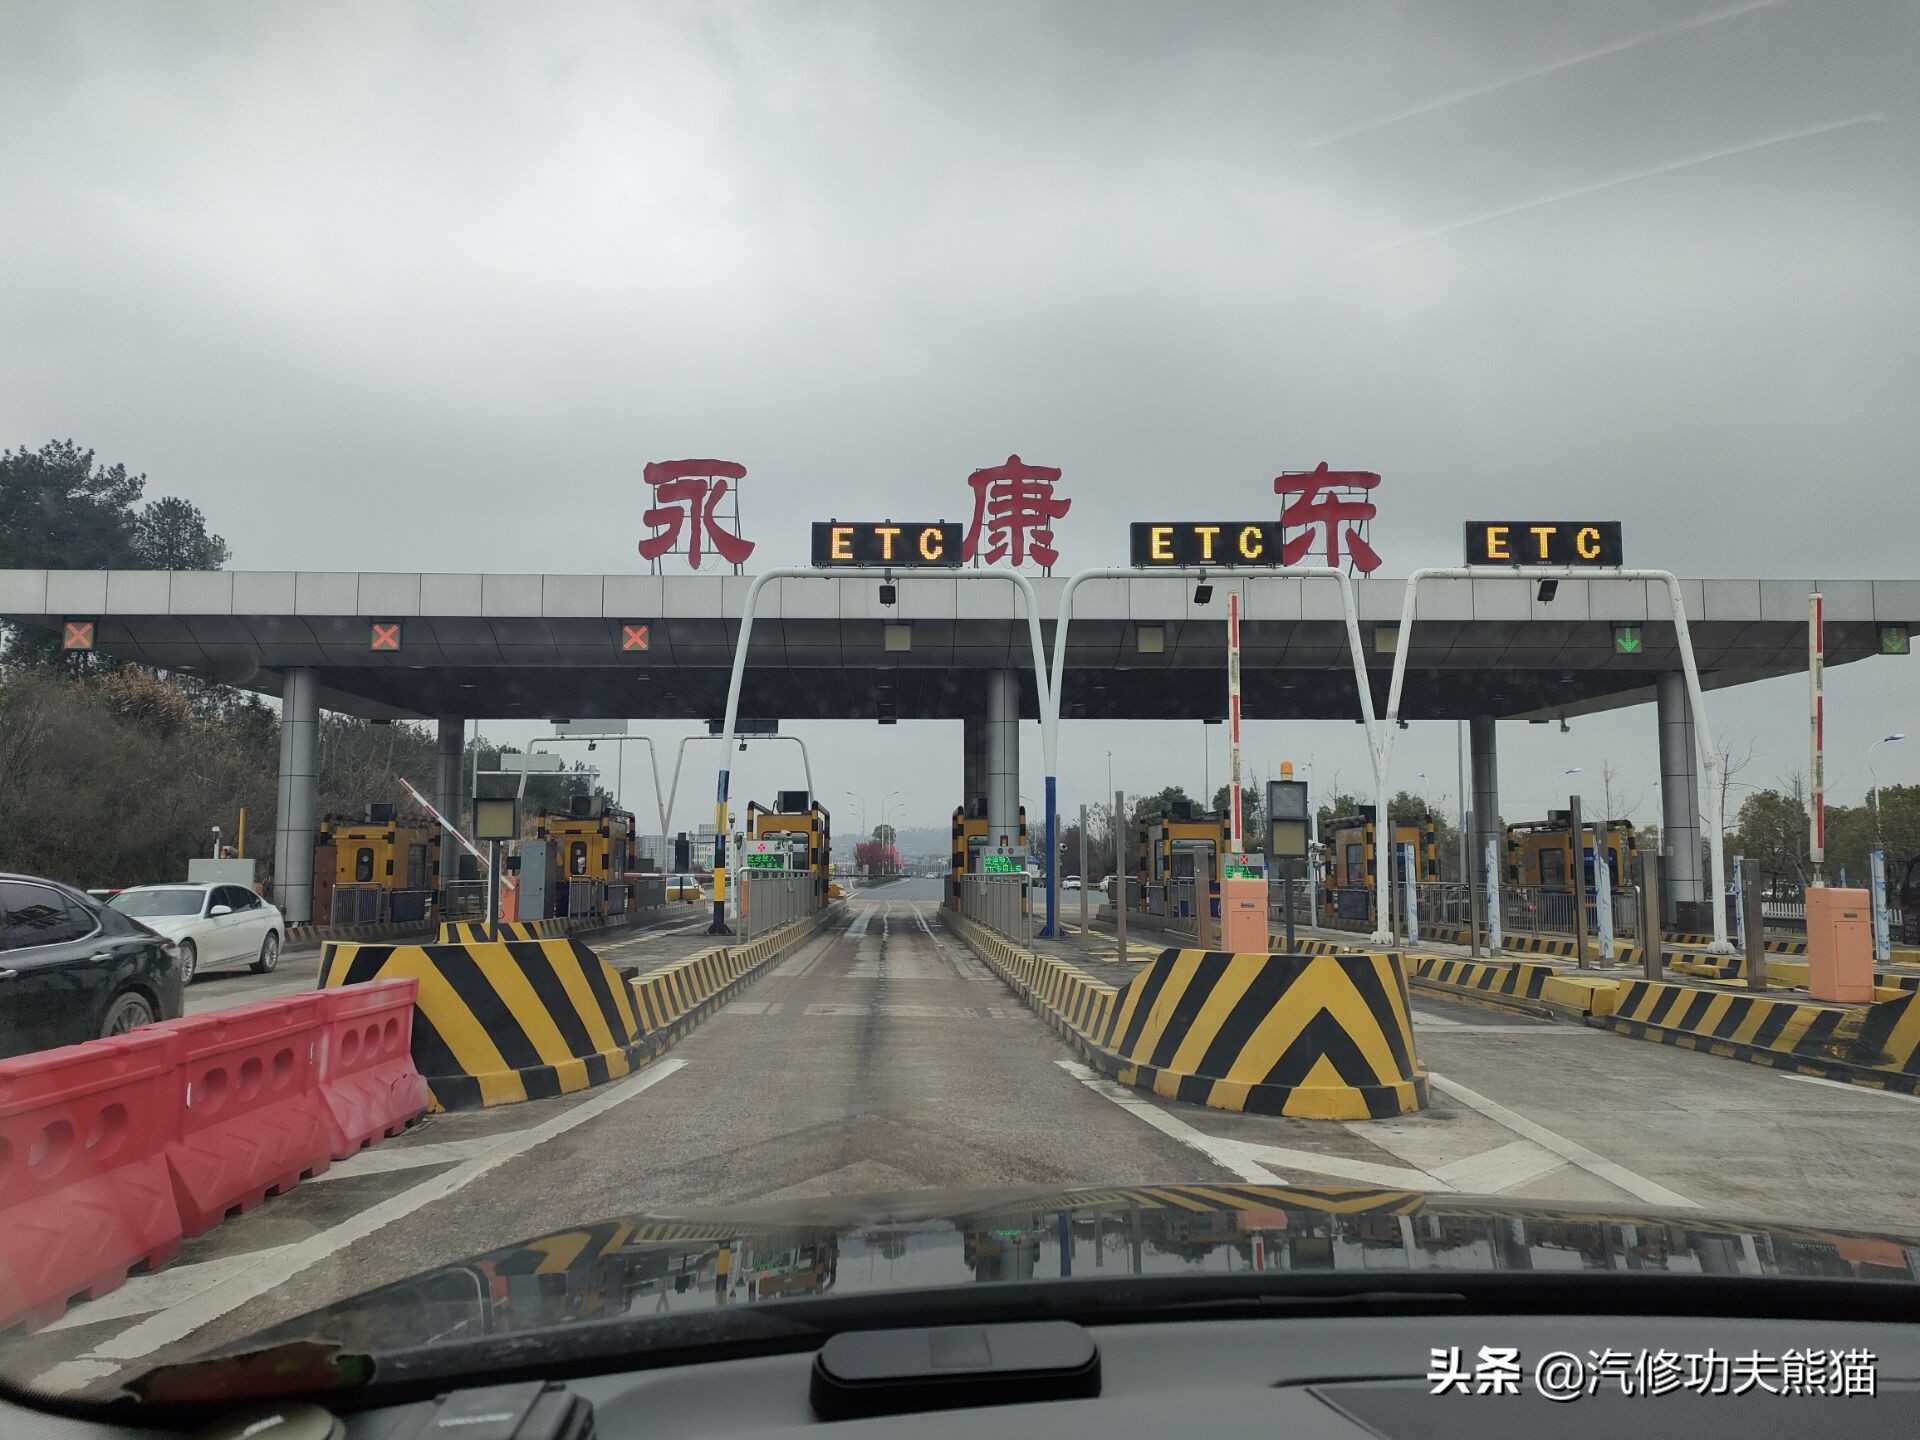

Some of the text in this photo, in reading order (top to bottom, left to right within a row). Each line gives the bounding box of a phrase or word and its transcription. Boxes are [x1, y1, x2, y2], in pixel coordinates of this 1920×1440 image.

[831, 527, 944, 560] ETC
[1151, 526, 1263, 560] ETC
[1487, 526, 1601, 560] ETC
